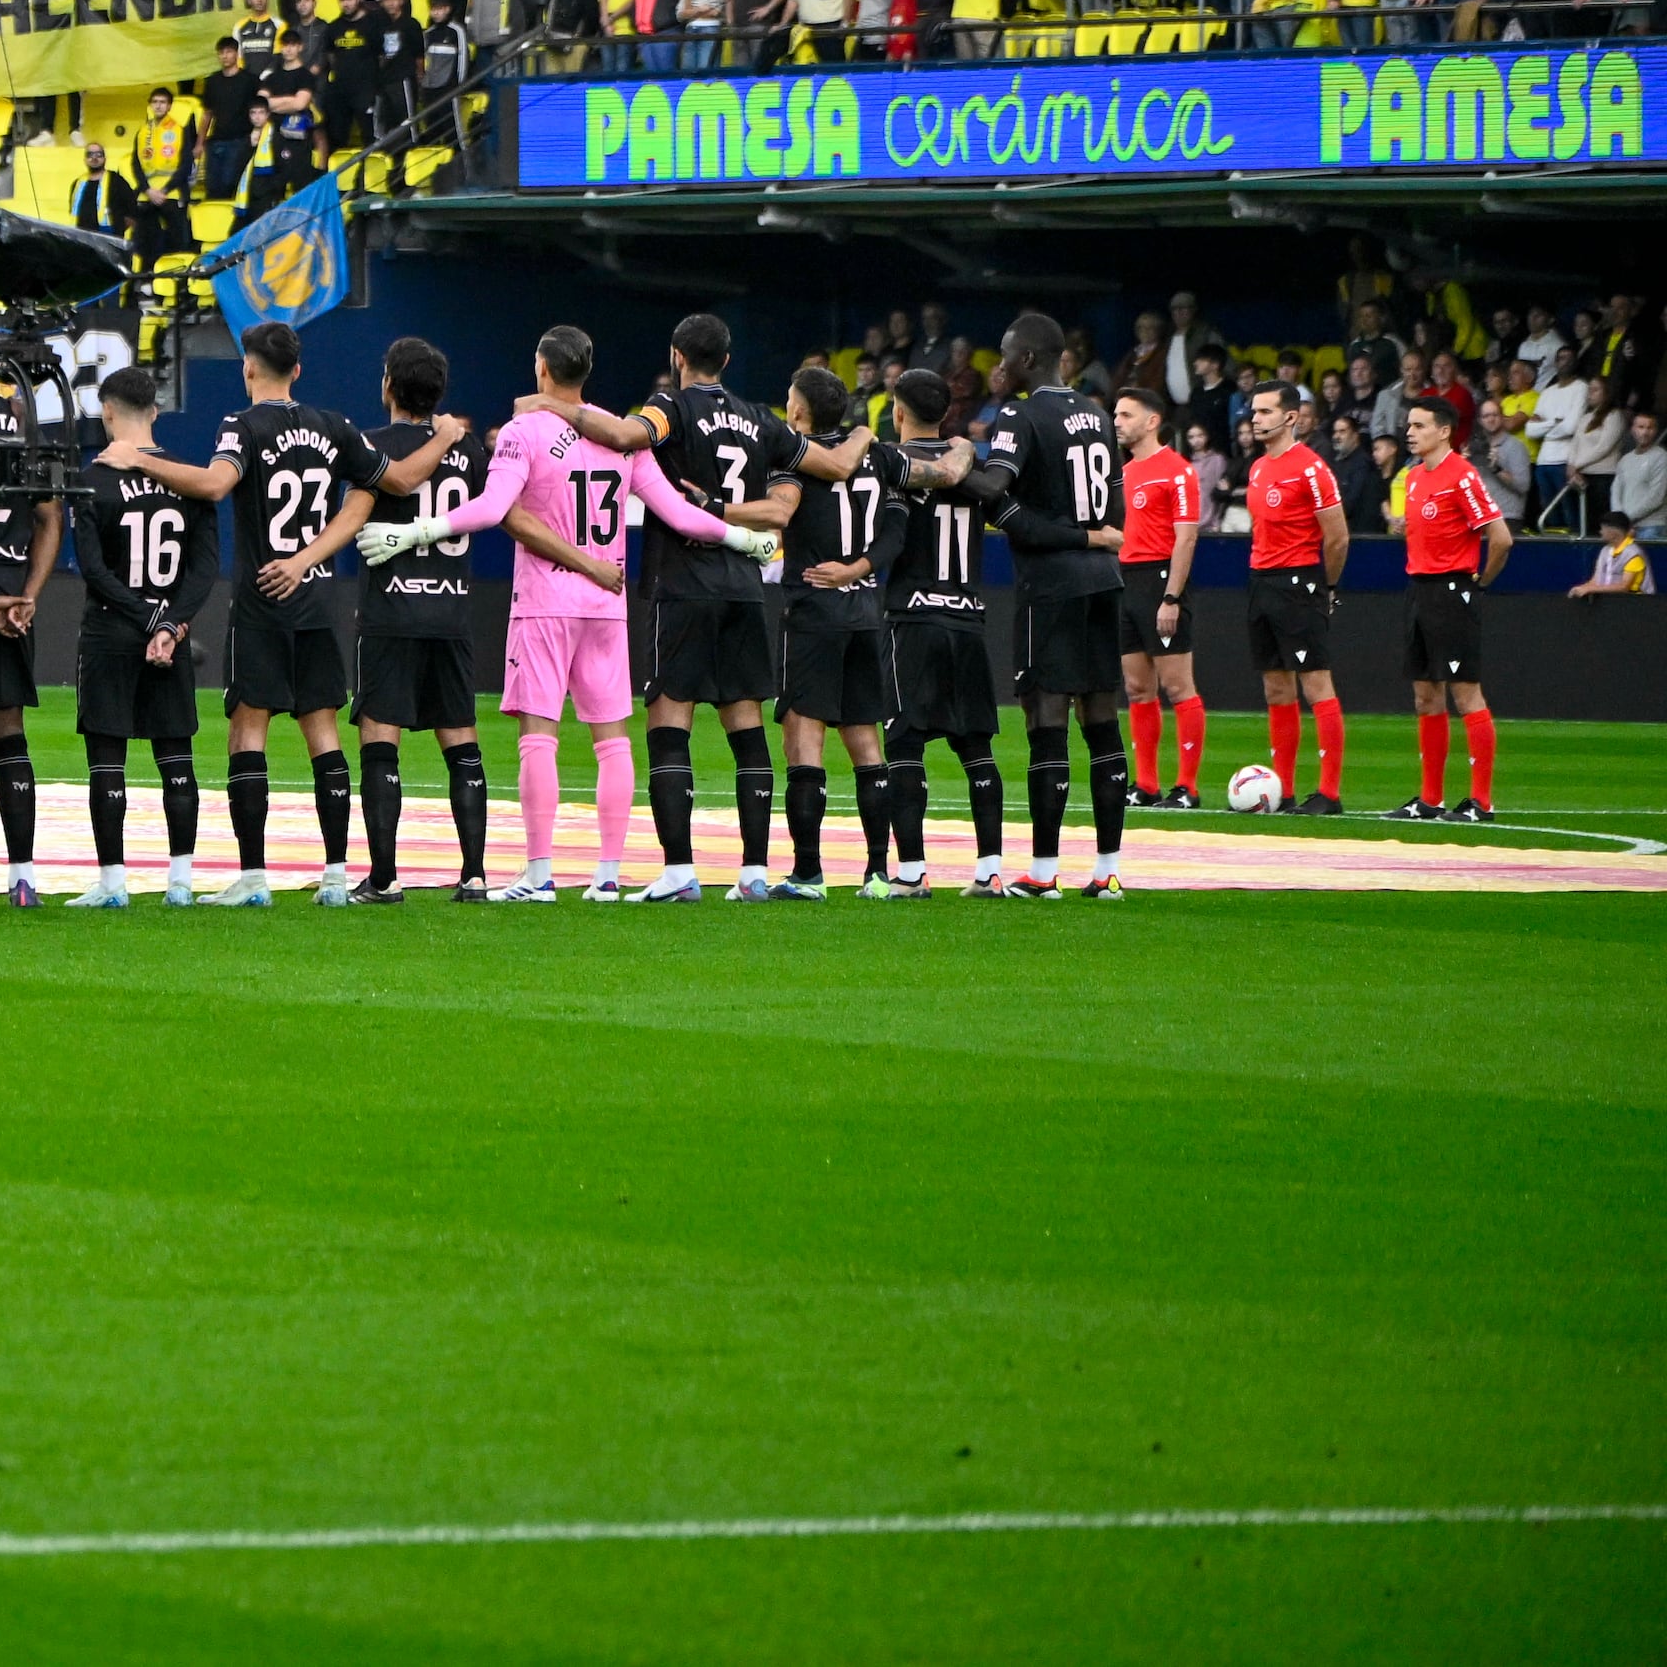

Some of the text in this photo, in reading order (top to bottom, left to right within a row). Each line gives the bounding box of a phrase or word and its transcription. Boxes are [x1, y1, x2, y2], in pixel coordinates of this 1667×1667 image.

[585, 50, 1644, 182] PAMESA cerámica PAMESA
[1063, 414, 1101, 435] GUEYE
[267, 468, 333, 553] 23
[568, 469, 622, 547] 13
[716, 444, 748, 504] 3
[1066, 442, 1111, 523] 18
[119, 508, 186, 588] 16
[413, 476, 470, 558] 10
[831, 477, 881, 557] 17
[934, 504, 970, 584] 11
